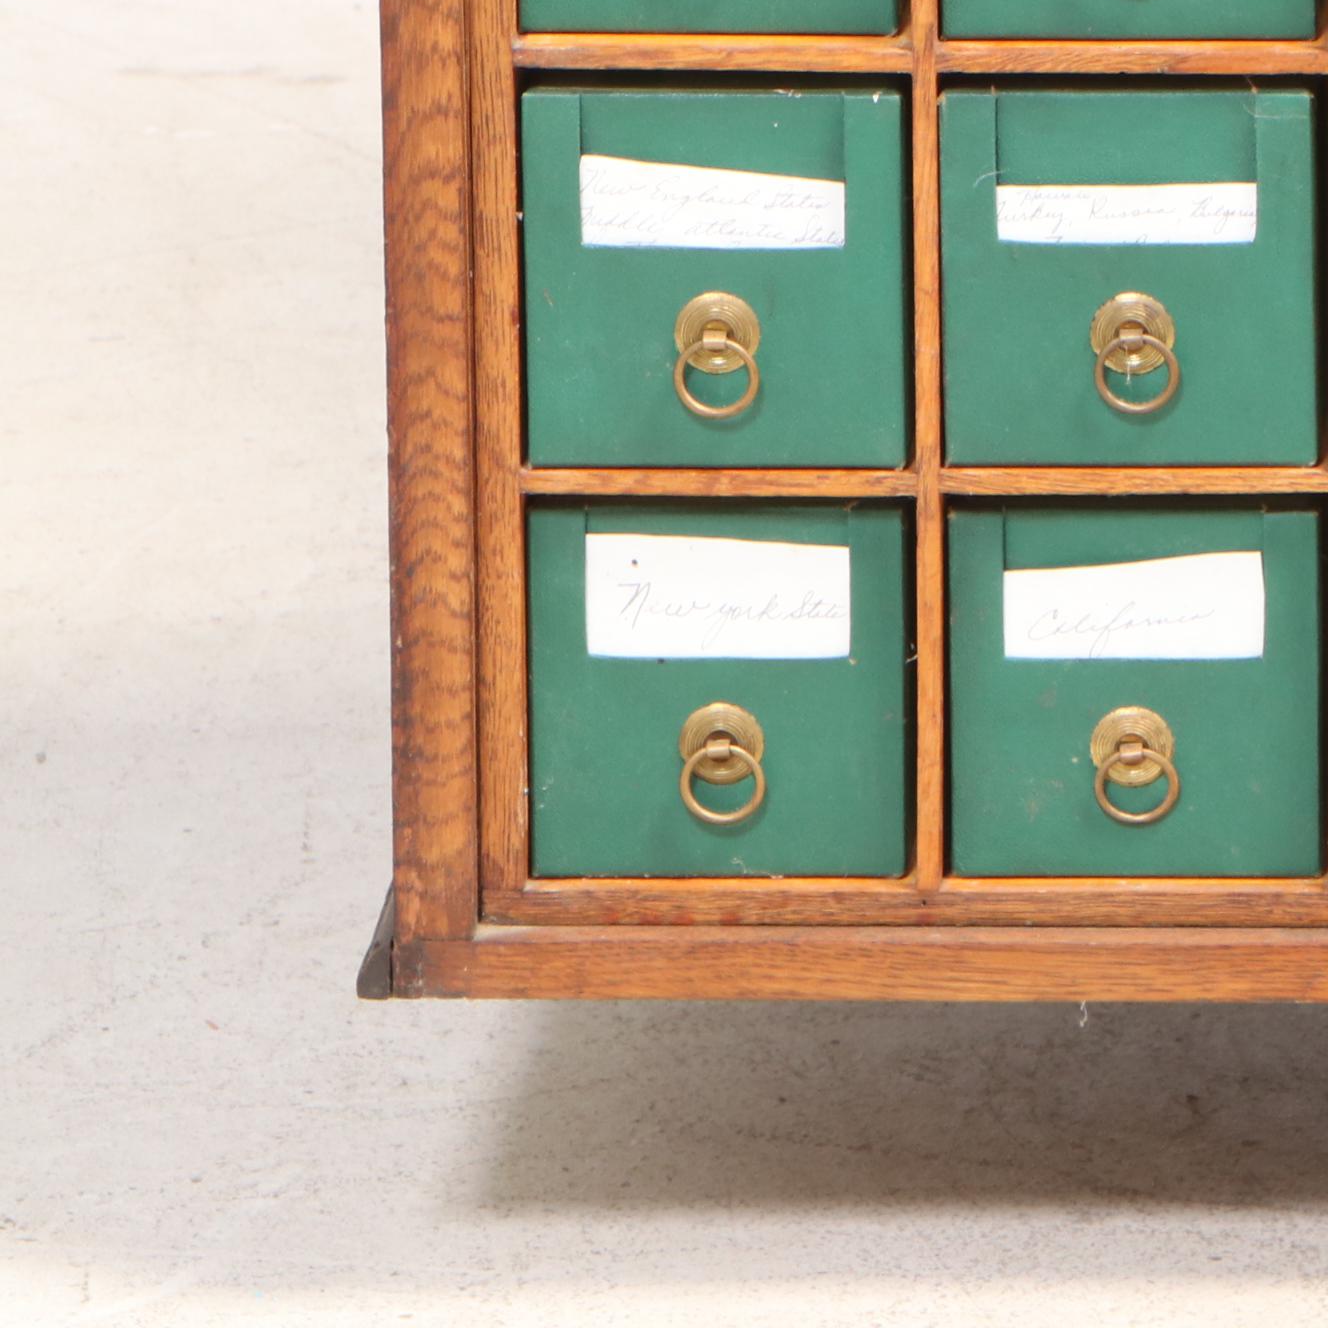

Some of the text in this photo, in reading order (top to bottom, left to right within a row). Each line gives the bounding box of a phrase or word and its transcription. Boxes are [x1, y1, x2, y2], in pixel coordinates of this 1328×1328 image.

[580, 168, 647, 196] New
[650, 175, 761, 222] England
[617, 581, 711, 630] New
[1026, 600, 1216, 658] California
